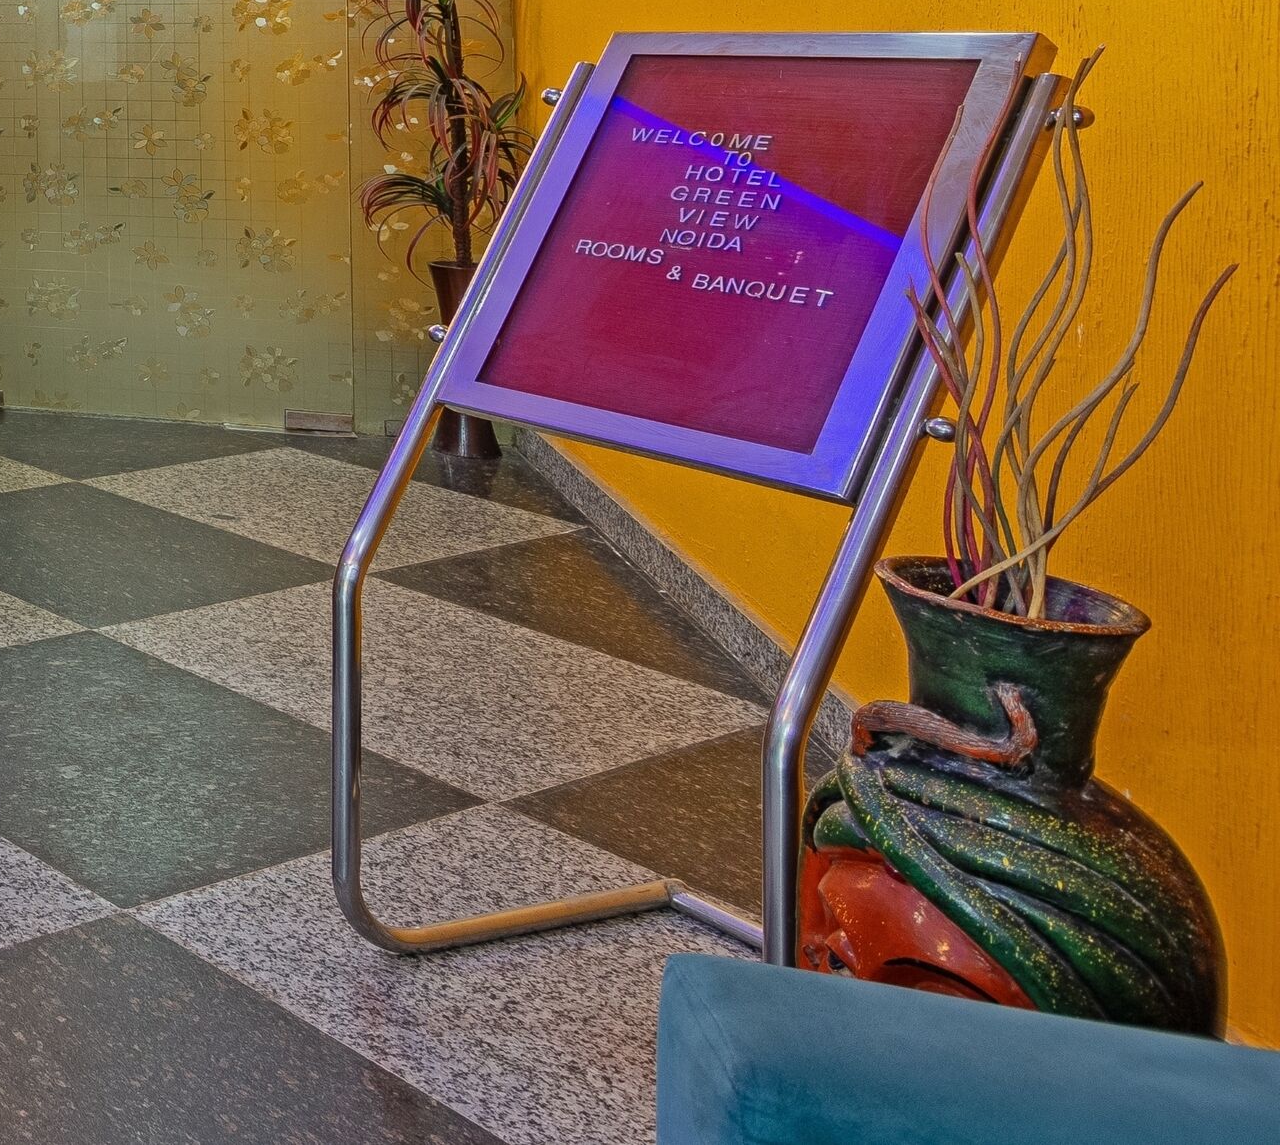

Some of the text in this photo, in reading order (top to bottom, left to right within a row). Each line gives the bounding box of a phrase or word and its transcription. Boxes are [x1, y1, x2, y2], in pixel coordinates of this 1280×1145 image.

[631, 127, 773, 151] WELCOME
[723, 150, 752, 167] TO
[684, 165, 781, 188] HOTEL
[670, 185, 781, 210] GREEN
[679, 207, 759, 231] VIEW
[659, 228, 742, 252] NOIDA
[575, 239, 834, 308] ROOMS & BANQUET
